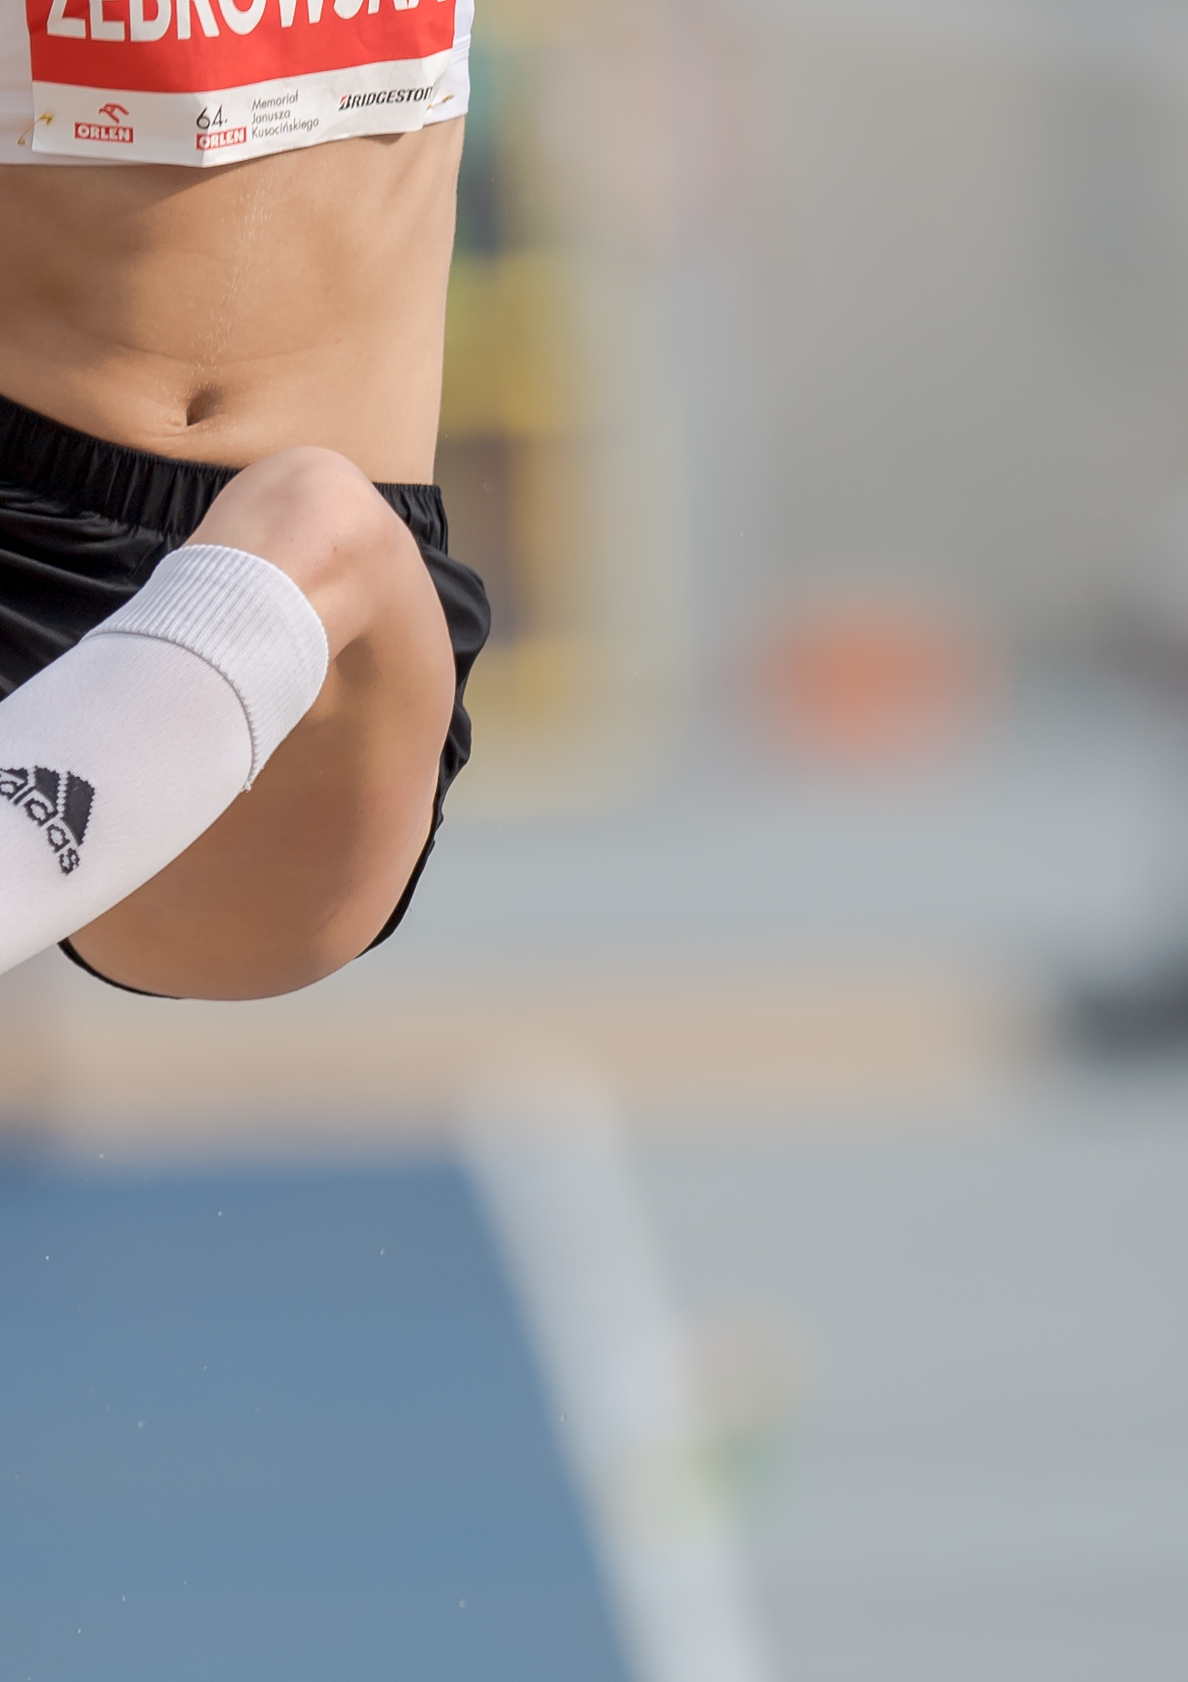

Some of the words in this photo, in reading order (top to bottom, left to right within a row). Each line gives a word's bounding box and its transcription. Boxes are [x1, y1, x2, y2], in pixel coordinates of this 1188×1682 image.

[251, 108, 291, 125] Janusza
[76, 124, 132, 142] ORLEN
[252, 118, 320, 140] Kusocińskiego
[198, 130, 245, 149] ORLEN
